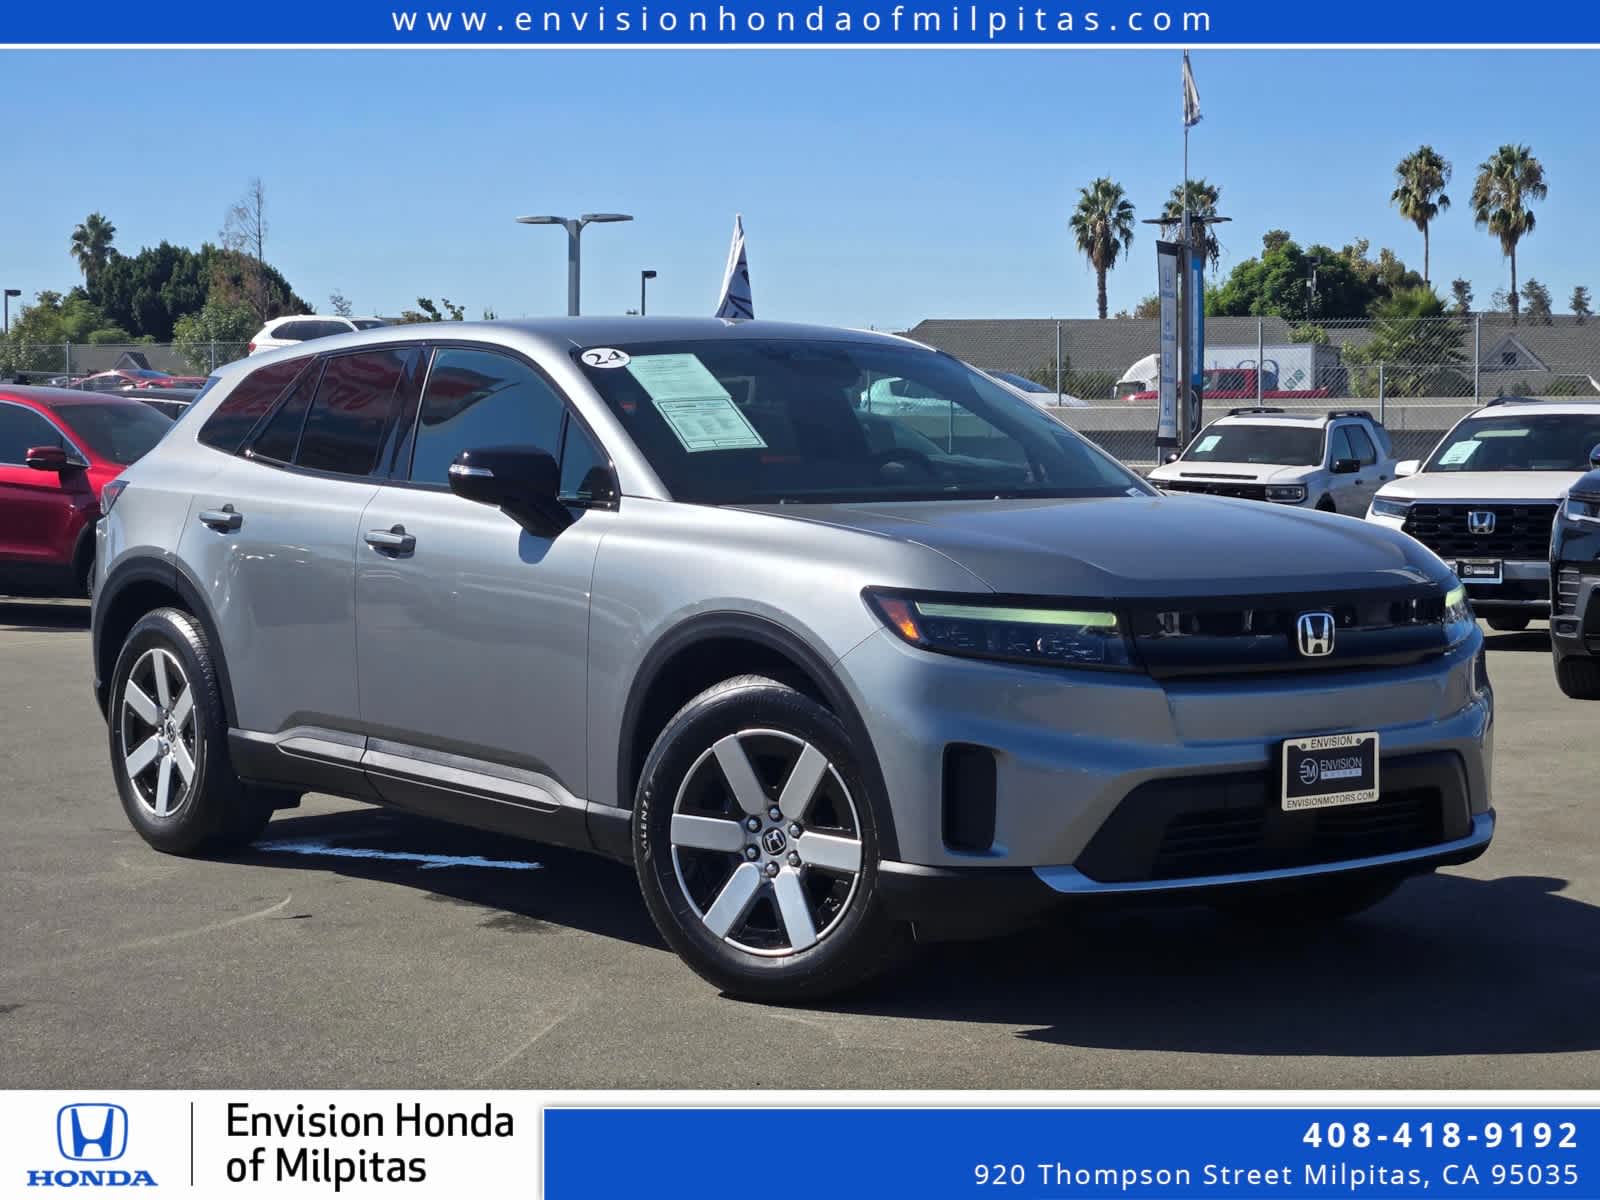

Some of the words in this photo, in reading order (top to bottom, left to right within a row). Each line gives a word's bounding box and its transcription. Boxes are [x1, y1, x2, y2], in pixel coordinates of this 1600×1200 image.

[586, 350, 625, 365] 24
[1310, 736, 1354, 749] ENVISION
[1320, 757, 1362, 771] ENVISION
[1286, 791, 1375, 809] ENVISIONMOTORS.COM
